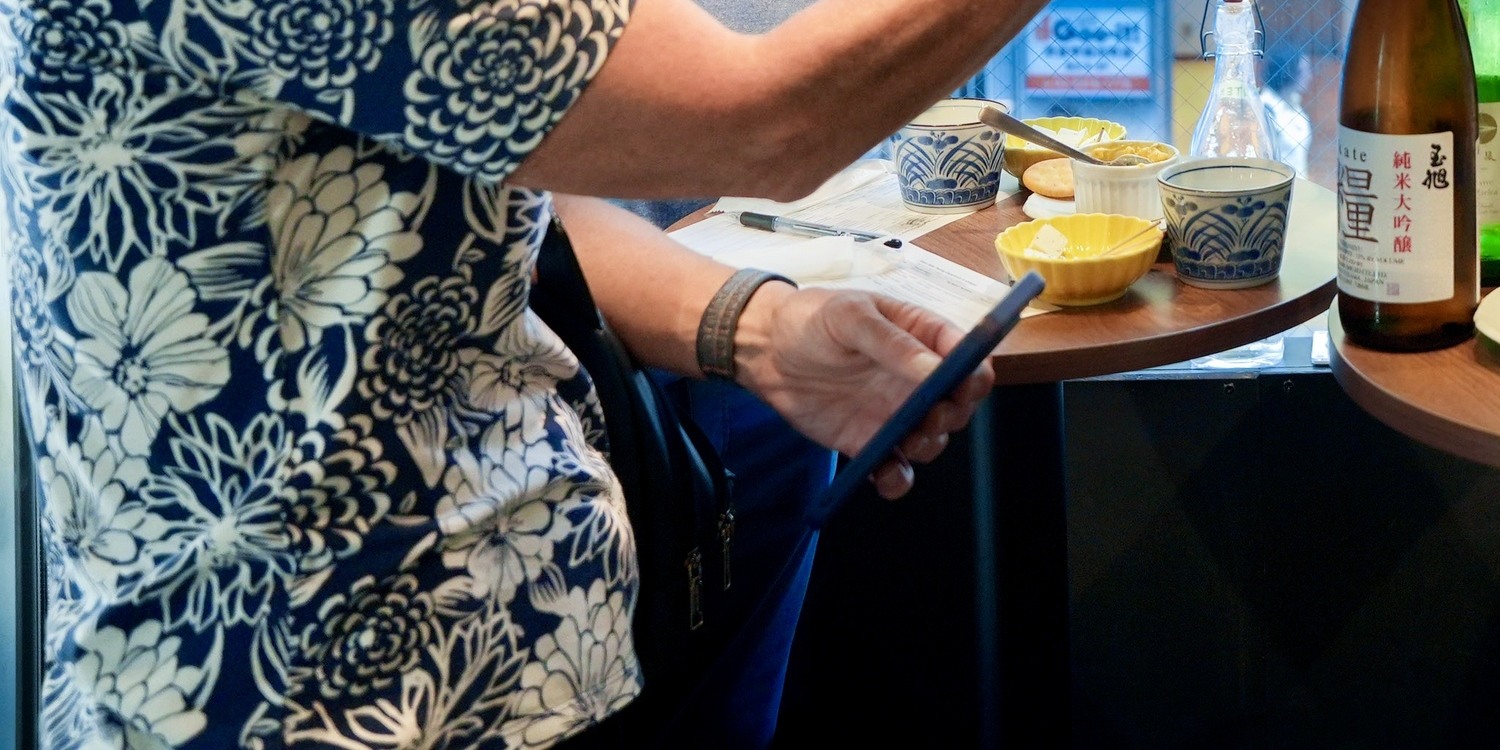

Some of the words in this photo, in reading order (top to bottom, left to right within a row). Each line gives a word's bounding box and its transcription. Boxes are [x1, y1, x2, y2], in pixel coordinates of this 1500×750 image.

[1393, 151, 1412, 253] 純米大吟醸
[1422, 143, 1449, 190] 玉旭
